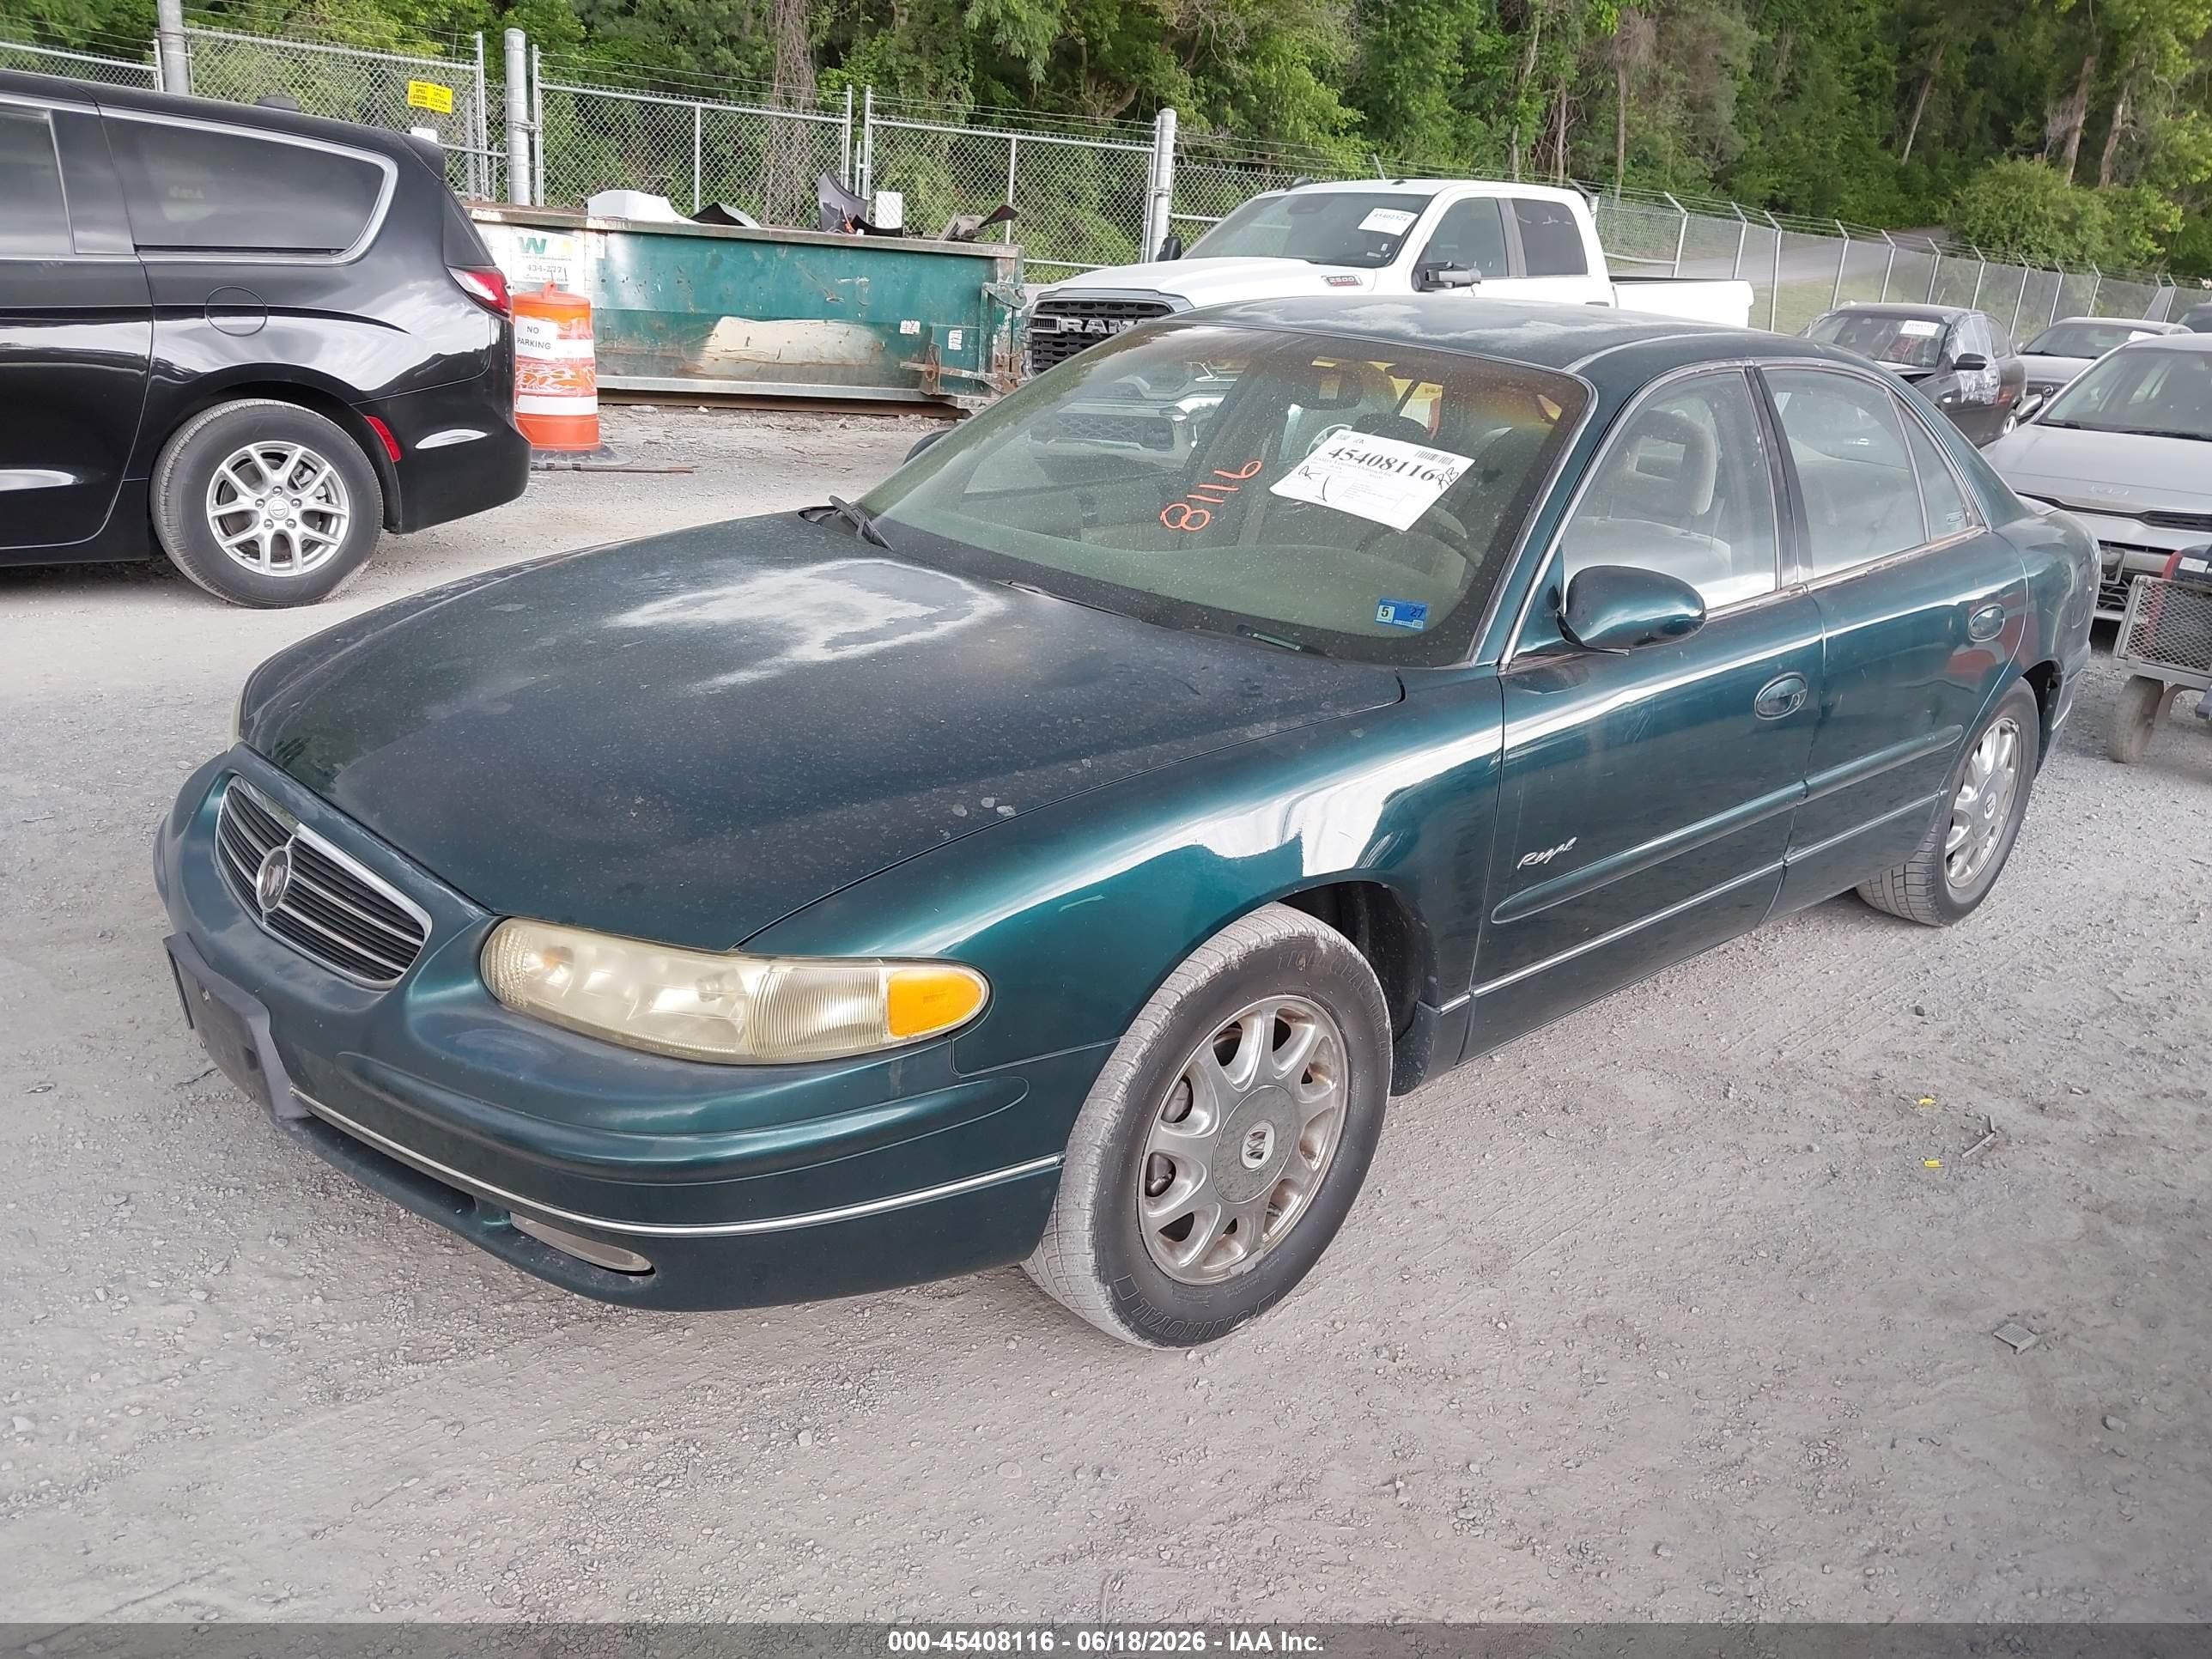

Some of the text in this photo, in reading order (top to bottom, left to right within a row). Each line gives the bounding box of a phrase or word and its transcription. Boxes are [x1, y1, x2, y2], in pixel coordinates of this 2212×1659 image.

[526, 325, 539, 334] NO
[1060, 319, 1135, 333] RAM
[517, 336, 551, 350] PARKING
[1328, 447, 1438, 482] 45408116
[1381, 606, 1389, 617] 5
[1410, 608, 1424, 617] 27
[1516, 836, 1577, 871] Regal
